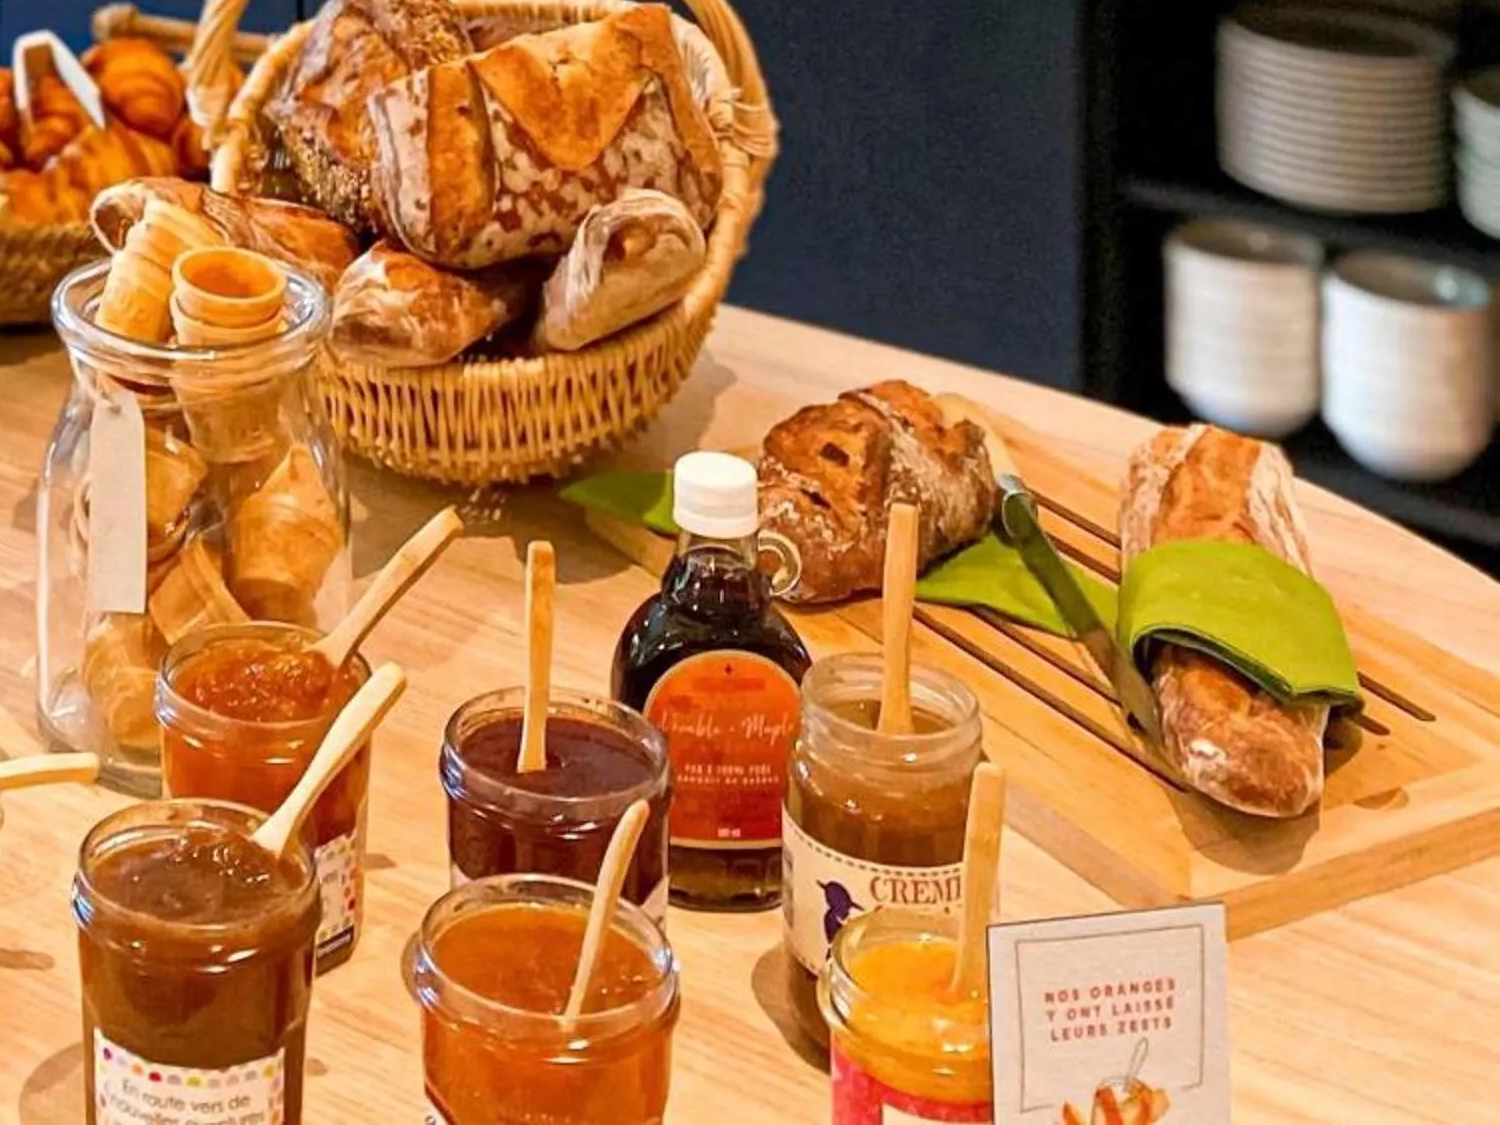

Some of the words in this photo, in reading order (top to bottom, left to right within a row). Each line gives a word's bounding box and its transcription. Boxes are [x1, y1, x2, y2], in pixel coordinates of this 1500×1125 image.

[1043, 988, 1080, 1004] NOS
[1090, 978, 1175, 999] ORANGES
[1045, 1010, 1056, 1023] Y
[1066, 1005, 1102, 1021] ONT
[1050, 1022, 1108, 1042] LEURS
[1117, 1016, 1173, 1035] ZESTS
[122, 1078, 140, 1097] En
[142, 1092, 185, 1111] route
[190, 1101, 225, 1114] vers
[228, 1095, 251, 1110] de
